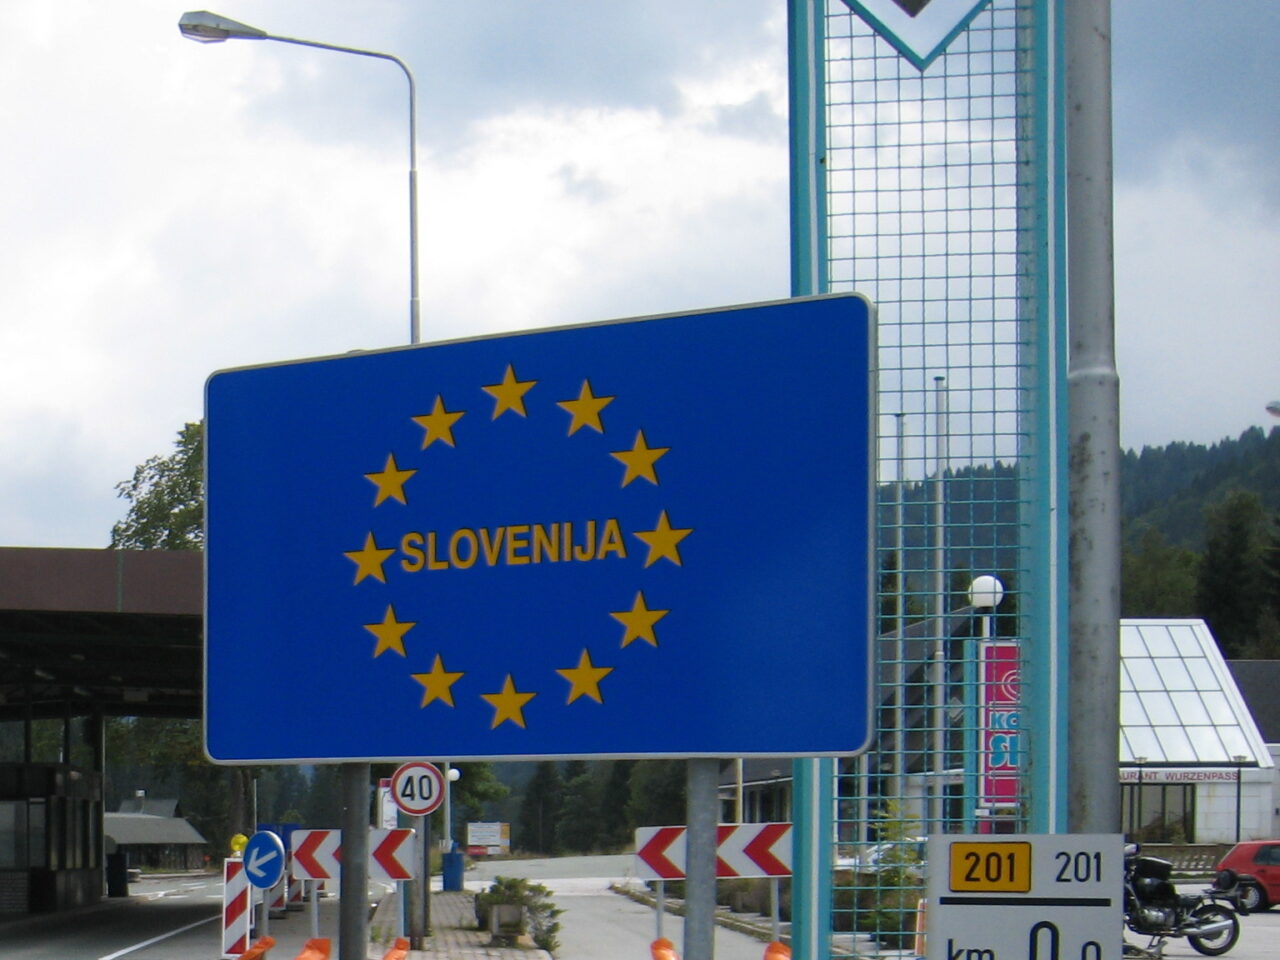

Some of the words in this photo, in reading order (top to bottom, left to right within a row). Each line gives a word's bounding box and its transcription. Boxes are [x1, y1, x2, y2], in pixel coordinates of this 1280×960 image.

[400, 518, 627, 573] SLOVENIJA
[401, 774, 433, 801] 40
[1165, 771, 1239, 781] WURZENPASS
[964, 851, 1016, 883] 201
[1055, 851, 1103, 883] 201
